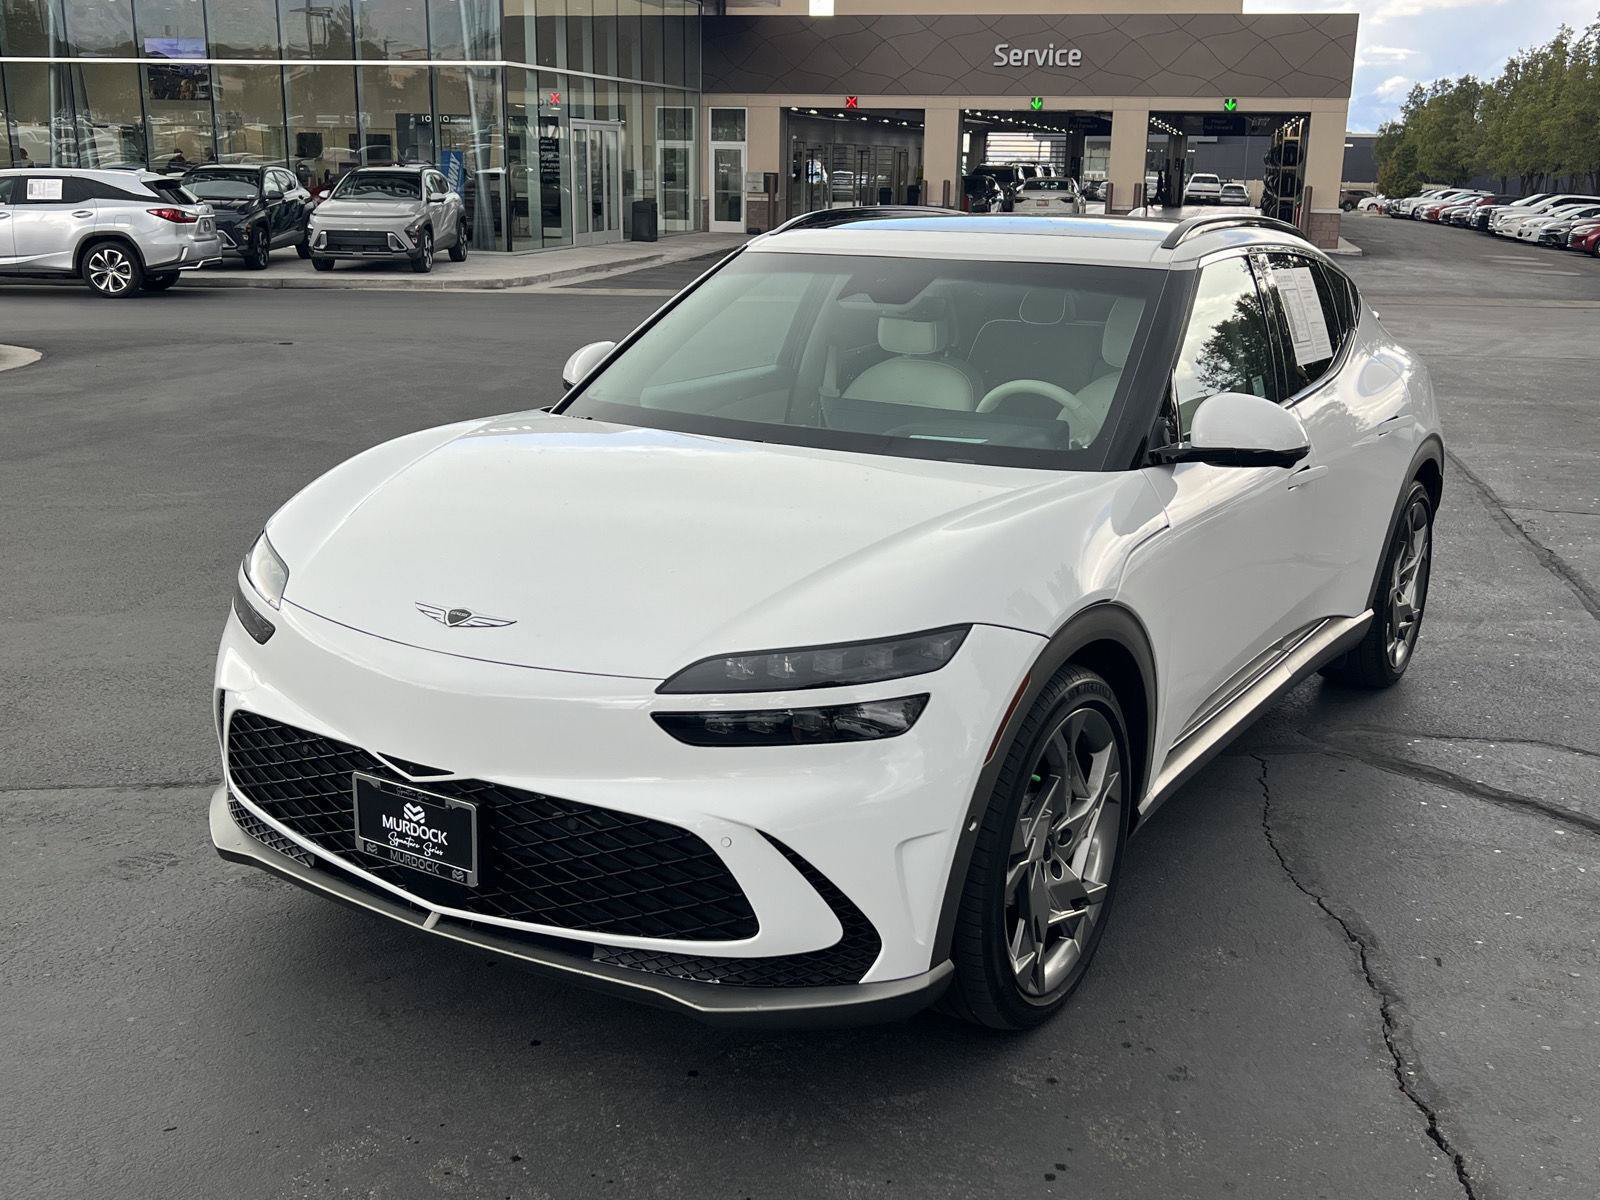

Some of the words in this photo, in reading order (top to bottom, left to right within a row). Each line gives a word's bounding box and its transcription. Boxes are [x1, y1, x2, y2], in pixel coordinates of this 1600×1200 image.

[993, 43, 1082, 67] Service
[382, 814, 448, 846] MURDOCK
[388, 831, 420, 849] Signature
[423, 841, 444, 857] Series
[390, 849, 440, 875] MURDOCK
